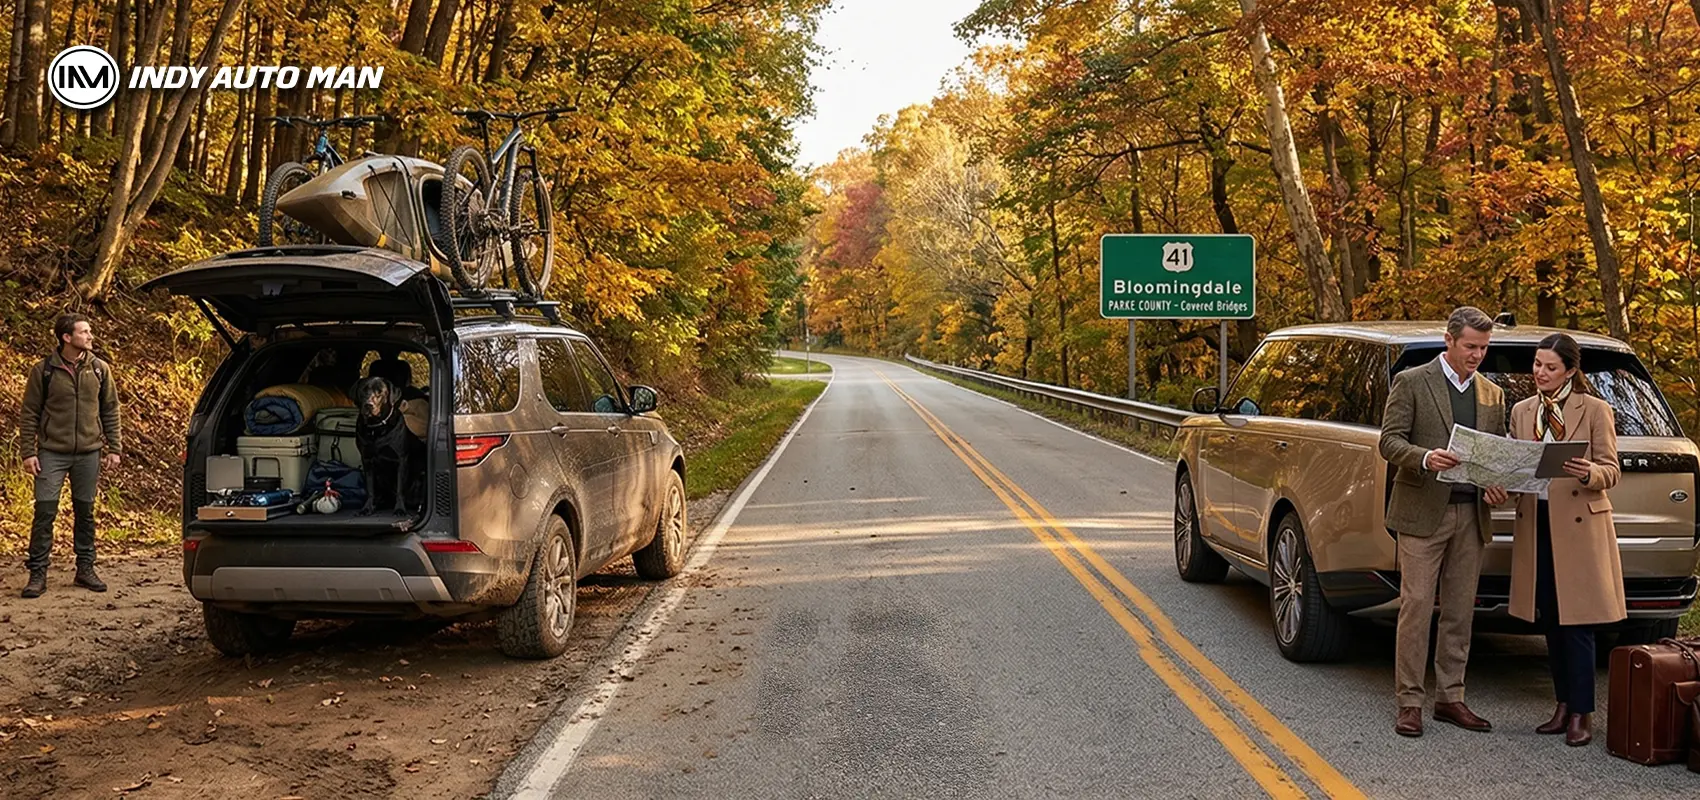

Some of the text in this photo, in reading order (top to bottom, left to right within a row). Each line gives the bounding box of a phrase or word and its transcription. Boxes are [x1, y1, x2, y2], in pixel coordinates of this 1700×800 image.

[1166, 248, 1188, 266] 41
[1113, 279, 1242, 298] Bloomingdale
[1108, 300, 1135, 311] PARKE
[1138, 300, 1172, 311] COUNTY
[1180, 300, 1214, 312] Covered
[1216, 300, 1248, 314] Bridges
[1622, 459, 1649, 467] ER
